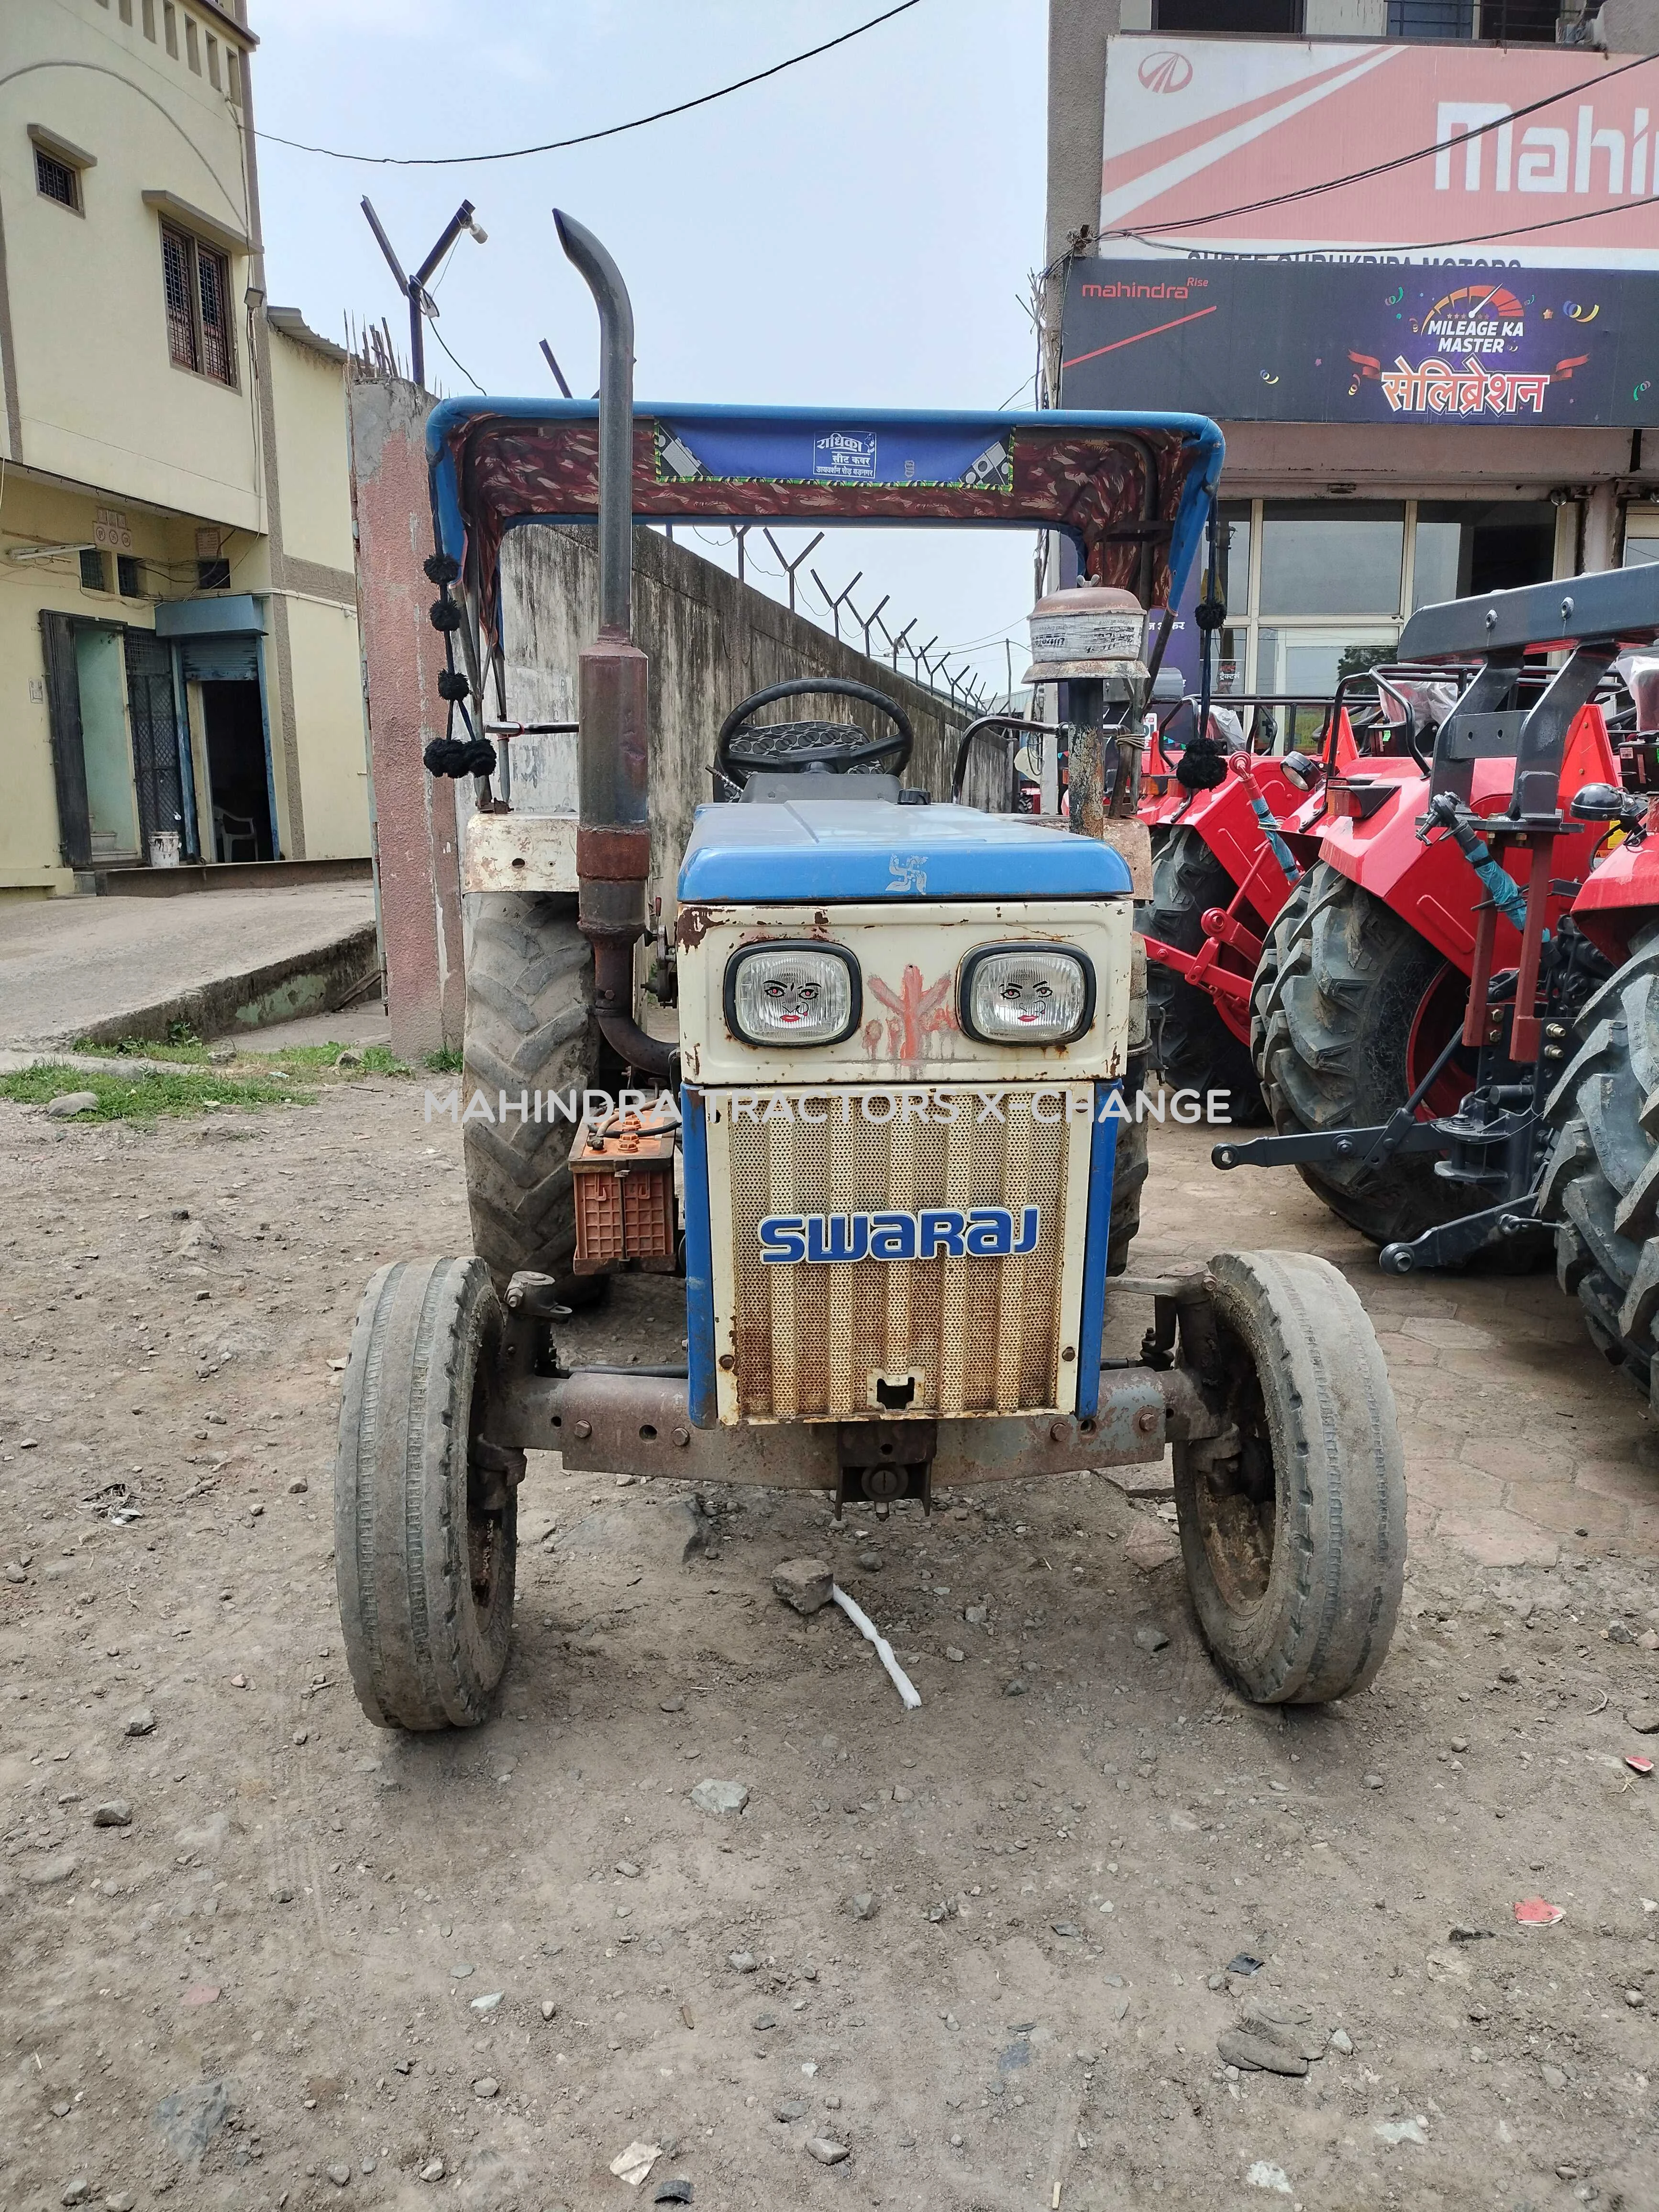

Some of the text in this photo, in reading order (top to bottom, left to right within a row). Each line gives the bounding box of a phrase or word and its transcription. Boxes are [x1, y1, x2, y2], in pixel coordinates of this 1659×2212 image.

[1082, 276, 1208, 299] mahindra Rise
[1427, 320, 1524, 336] MILEAGE KA
[1437, 338, 1505, 353] MASTER
[1381, 354, 1551, 413] सेलिब्रेशन
[817, 432, 863, 452] राधिका
[832, 453, 871, 465] सीट कवर
